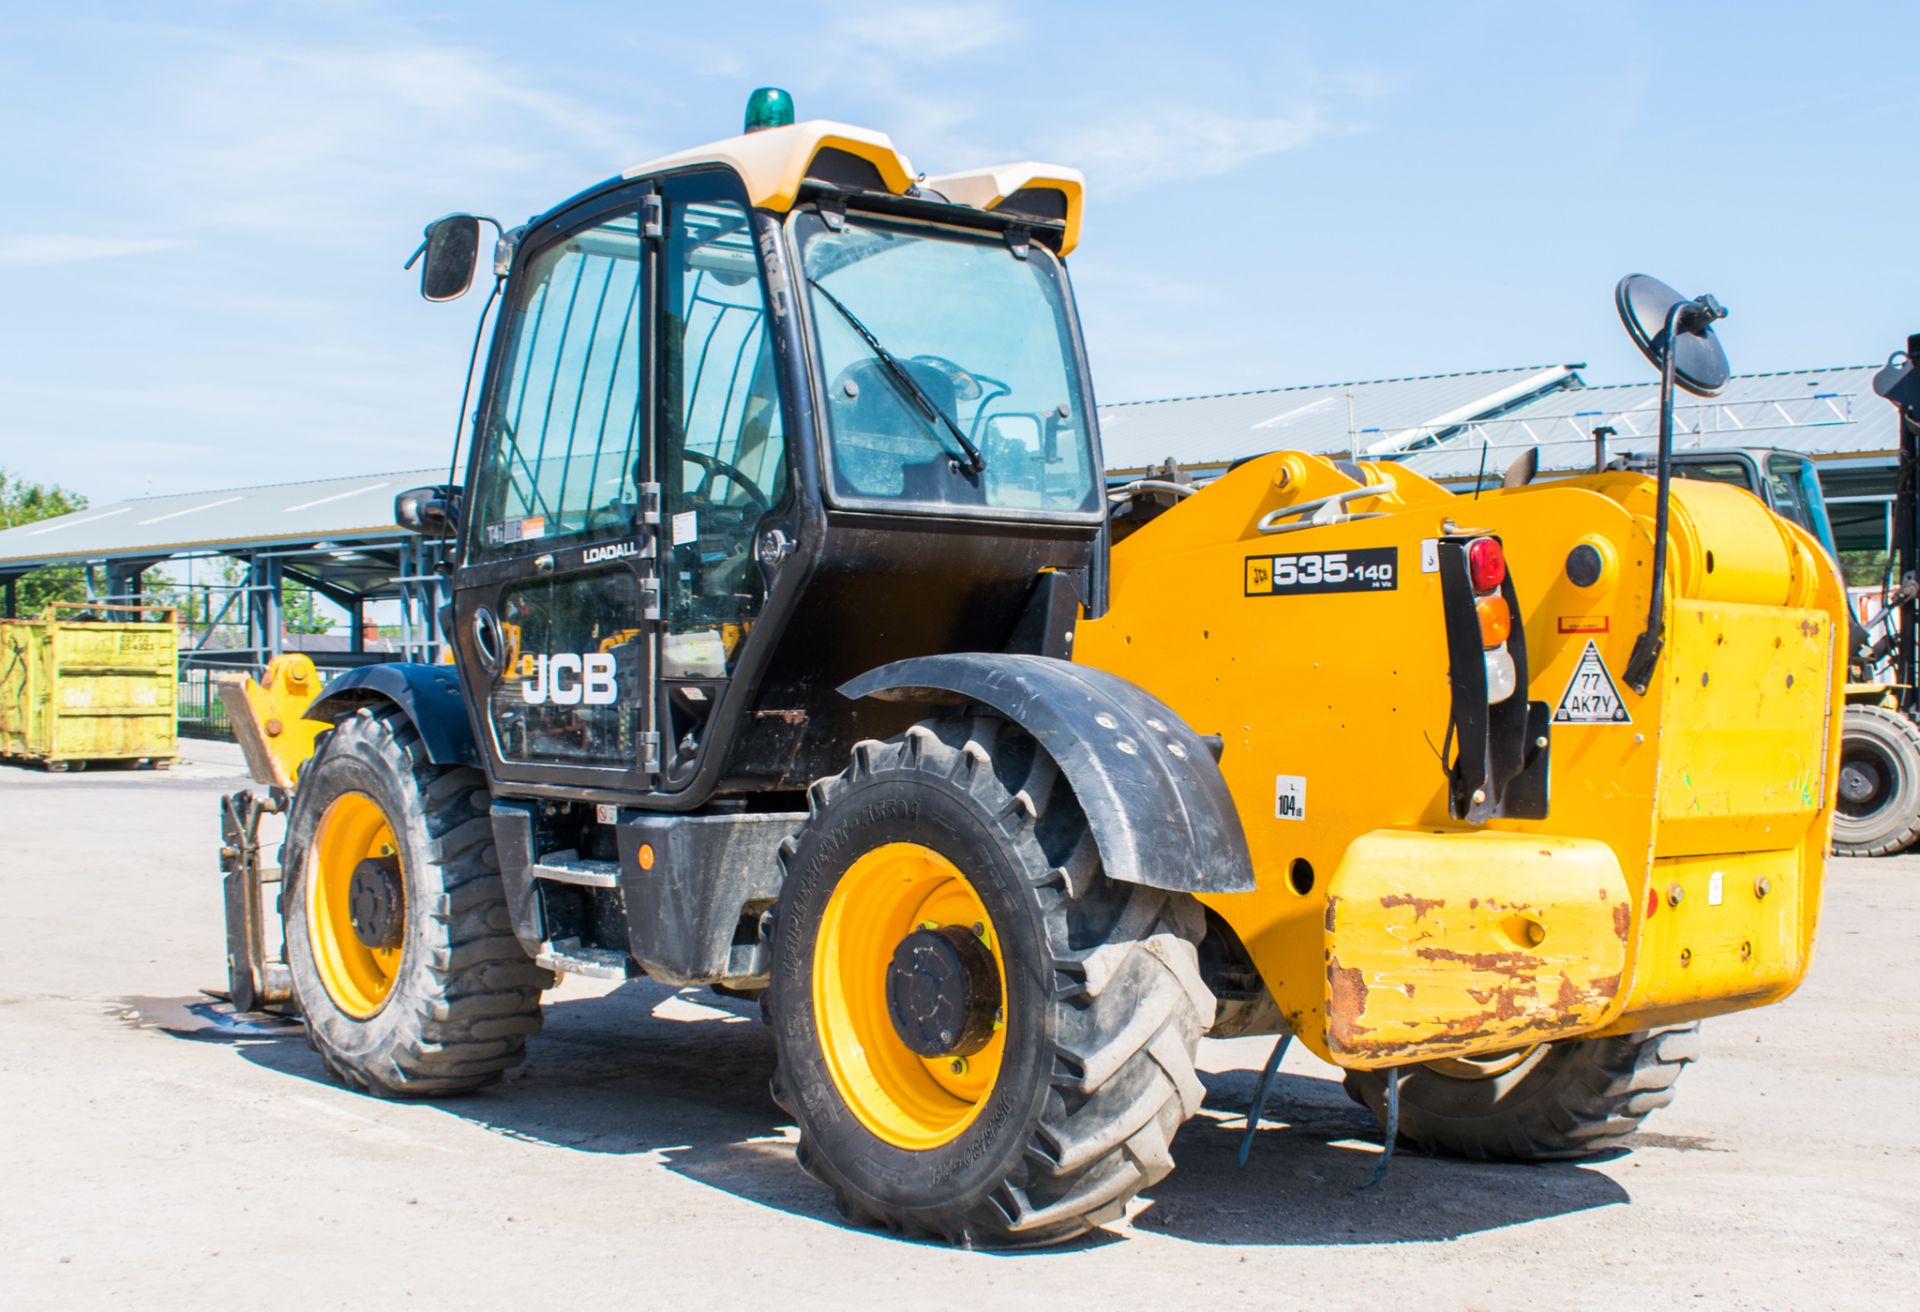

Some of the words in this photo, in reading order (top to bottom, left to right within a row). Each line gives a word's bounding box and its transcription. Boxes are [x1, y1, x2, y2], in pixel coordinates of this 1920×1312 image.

[583, 541, 638, 564] LOADALL
[1253, 567, 1268, 584] JCB
[1273, 553, 1393, 585] 535-140
[521, 653, 618, 705] JCB
[1582, 673, 1600, 690] 77
[1571, 695, 1611, 713] AK7Y
[1278, 794, 1295, 816] 104
